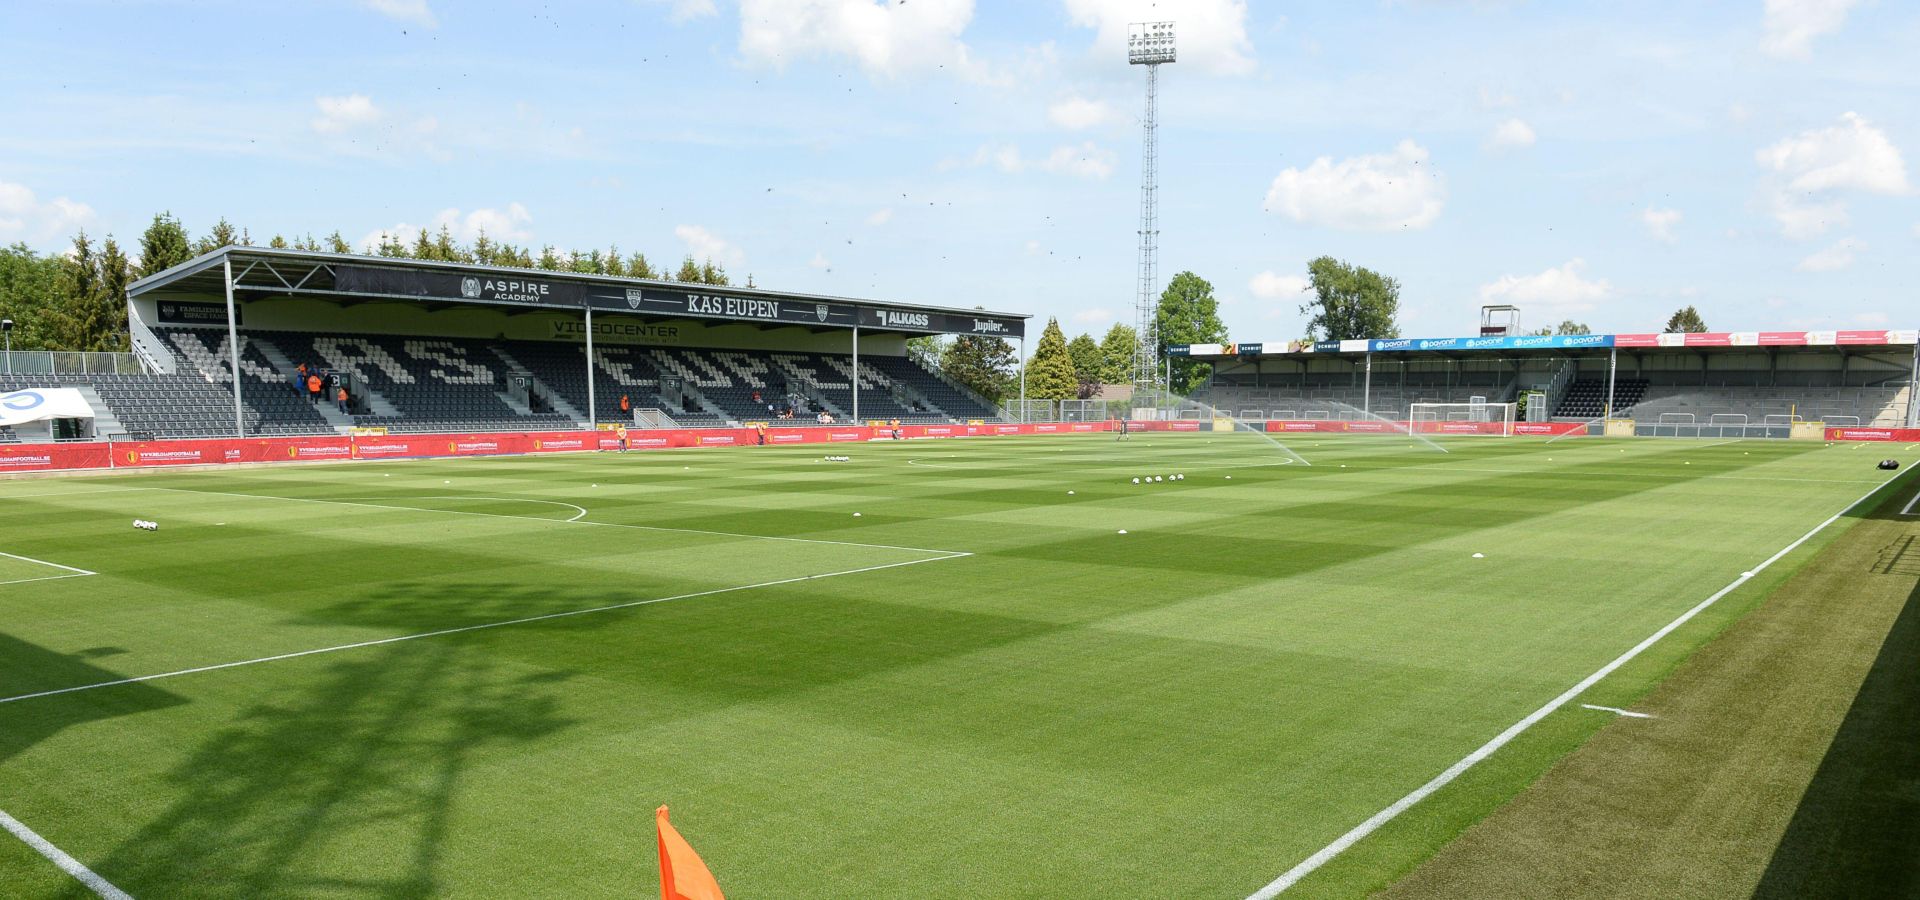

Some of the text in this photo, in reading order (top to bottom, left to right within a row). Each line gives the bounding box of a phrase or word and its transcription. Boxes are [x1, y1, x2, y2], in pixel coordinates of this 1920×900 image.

[484, 280, 550, 296] ASPIRE
[494, 292, 540, 302] ACADEMY
[180, 306, 239, 314] FAMILIENBLOK
[687, 294, 779, 318] KAS EUPEN
[888, 311, 929, 326] ALKASS
[972, 318, 1003, 334] Jupiler
[554, 321, 679, 337] VIDEOCENTER
